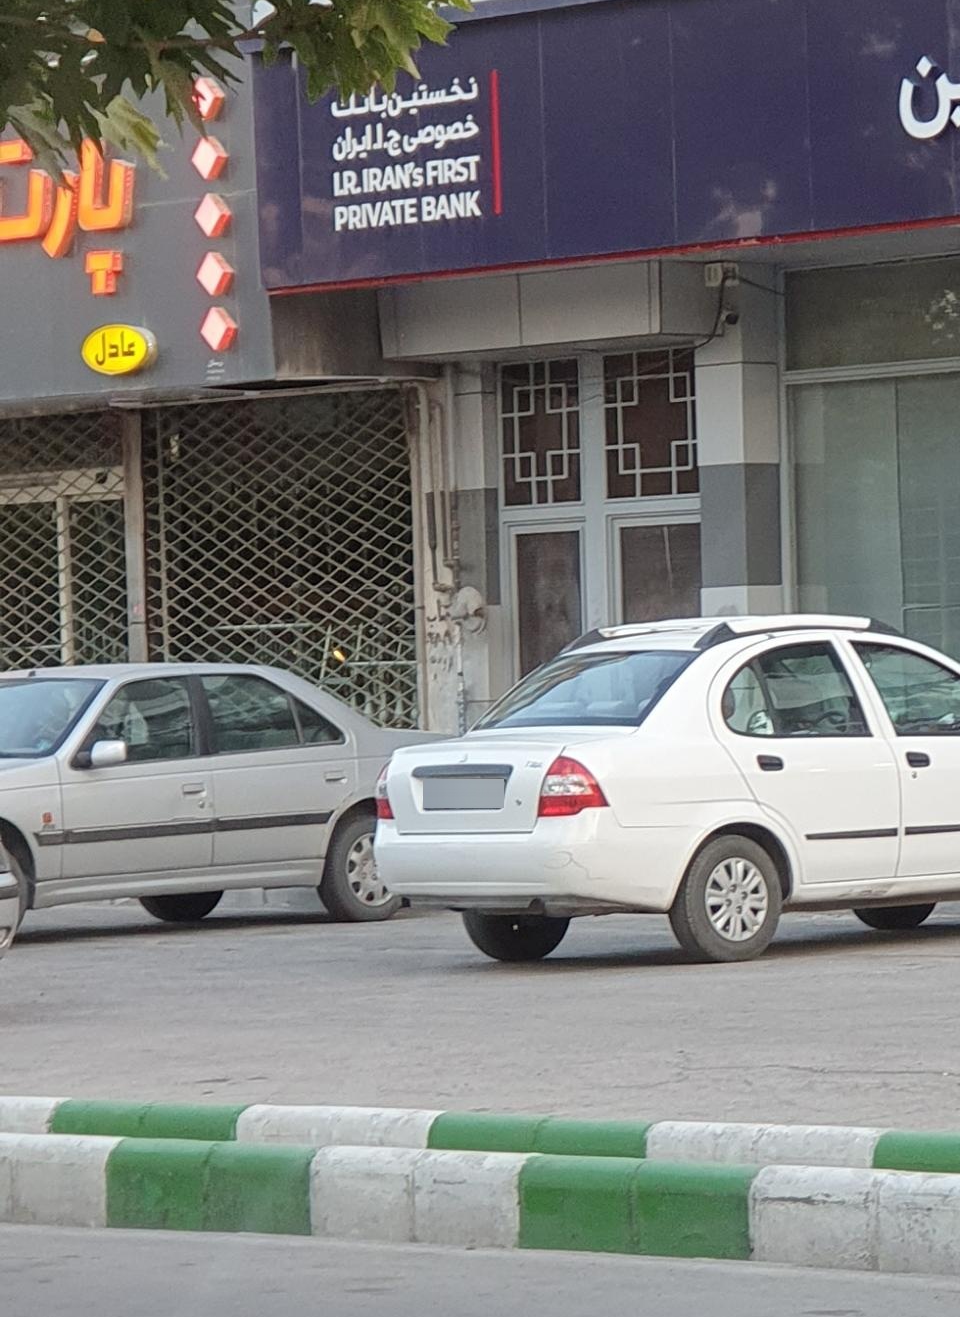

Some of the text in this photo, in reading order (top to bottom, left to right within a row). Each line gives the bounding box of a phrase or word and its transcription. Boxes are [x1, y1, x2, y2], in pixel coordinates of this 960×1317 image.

[388, 77, 479, 117] نخستین
[402, 114, 480, 153] خصوصی
[425, 155, 480, 185] FIRST
[334, 190, 482, 231] PRIVATE BANK
[95, 331, 136, 366] عادل
